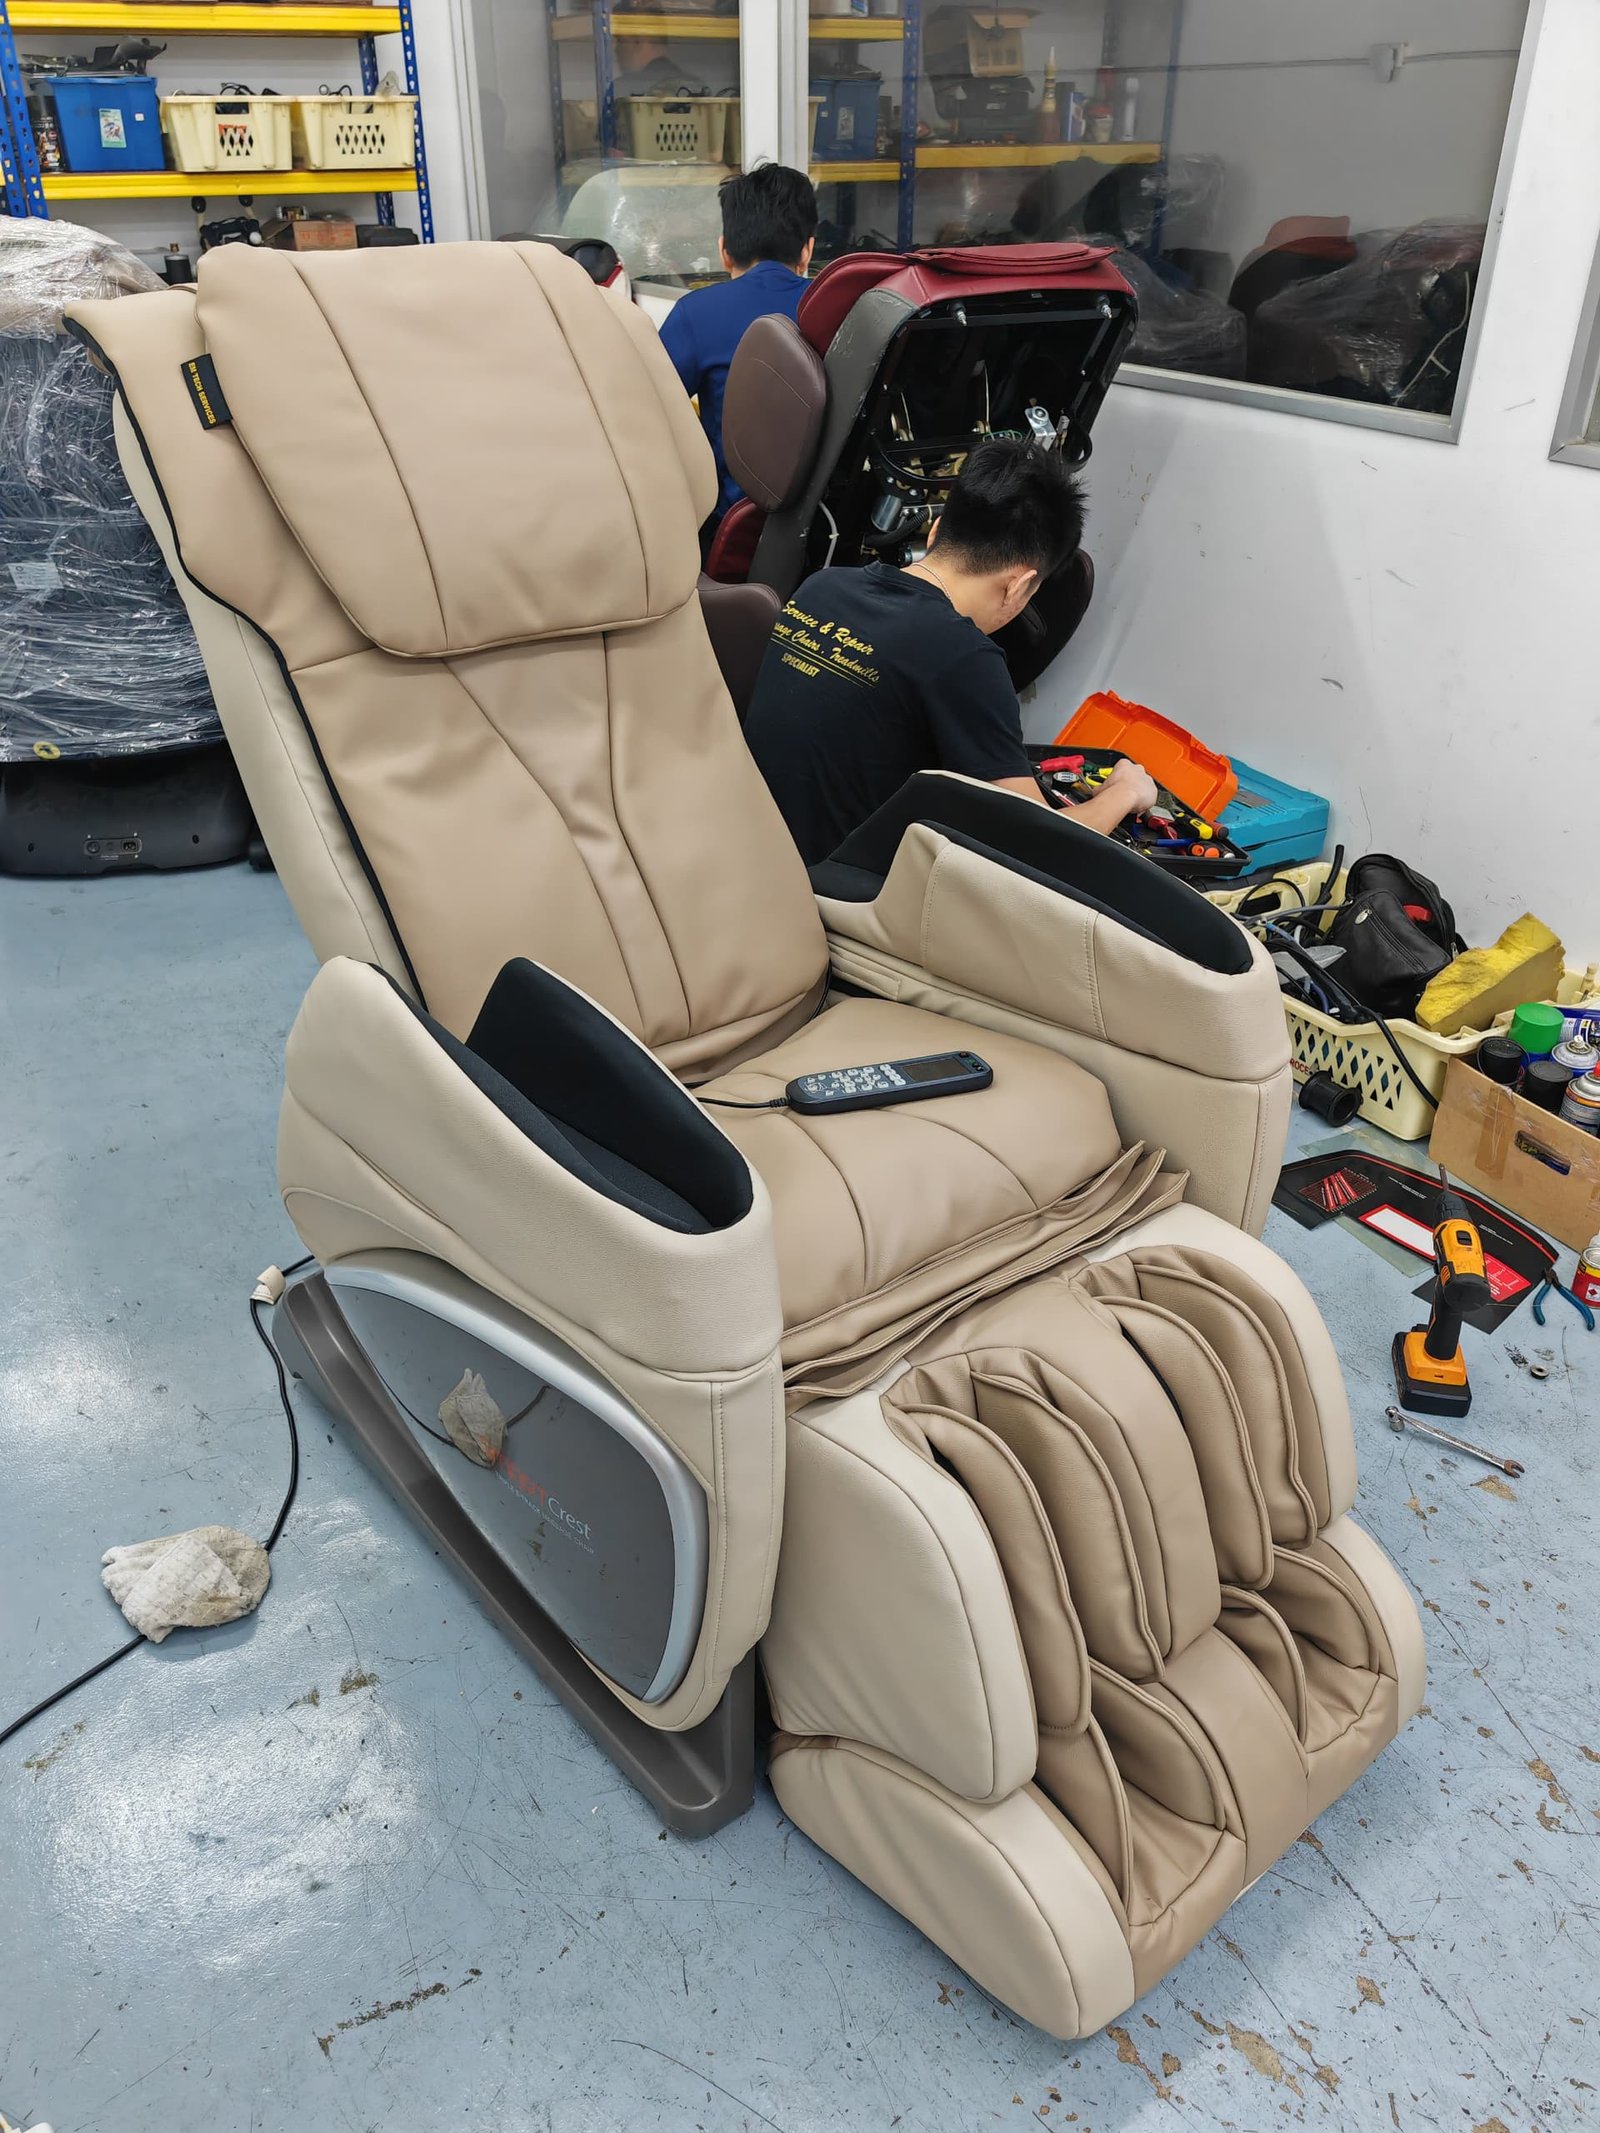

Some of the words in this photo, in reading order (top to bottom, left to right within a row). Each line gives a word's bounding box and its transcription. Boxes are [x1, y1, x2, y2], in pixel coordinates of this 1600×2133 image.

[192, 372, 204, 392] TECH
[199, 391, 217, 425] SERVICES
[781, 600, 819, 628] Service
[819, 621, 835, 635] &
[831, 627, 875, 655] Repair
[781, 652, 821, 678] SPECIALIST
[791, 630, 821, 652] Chairs
[829, 647, 881, 682] Treadmills
[548, 1497, 592, 1541] Crest
